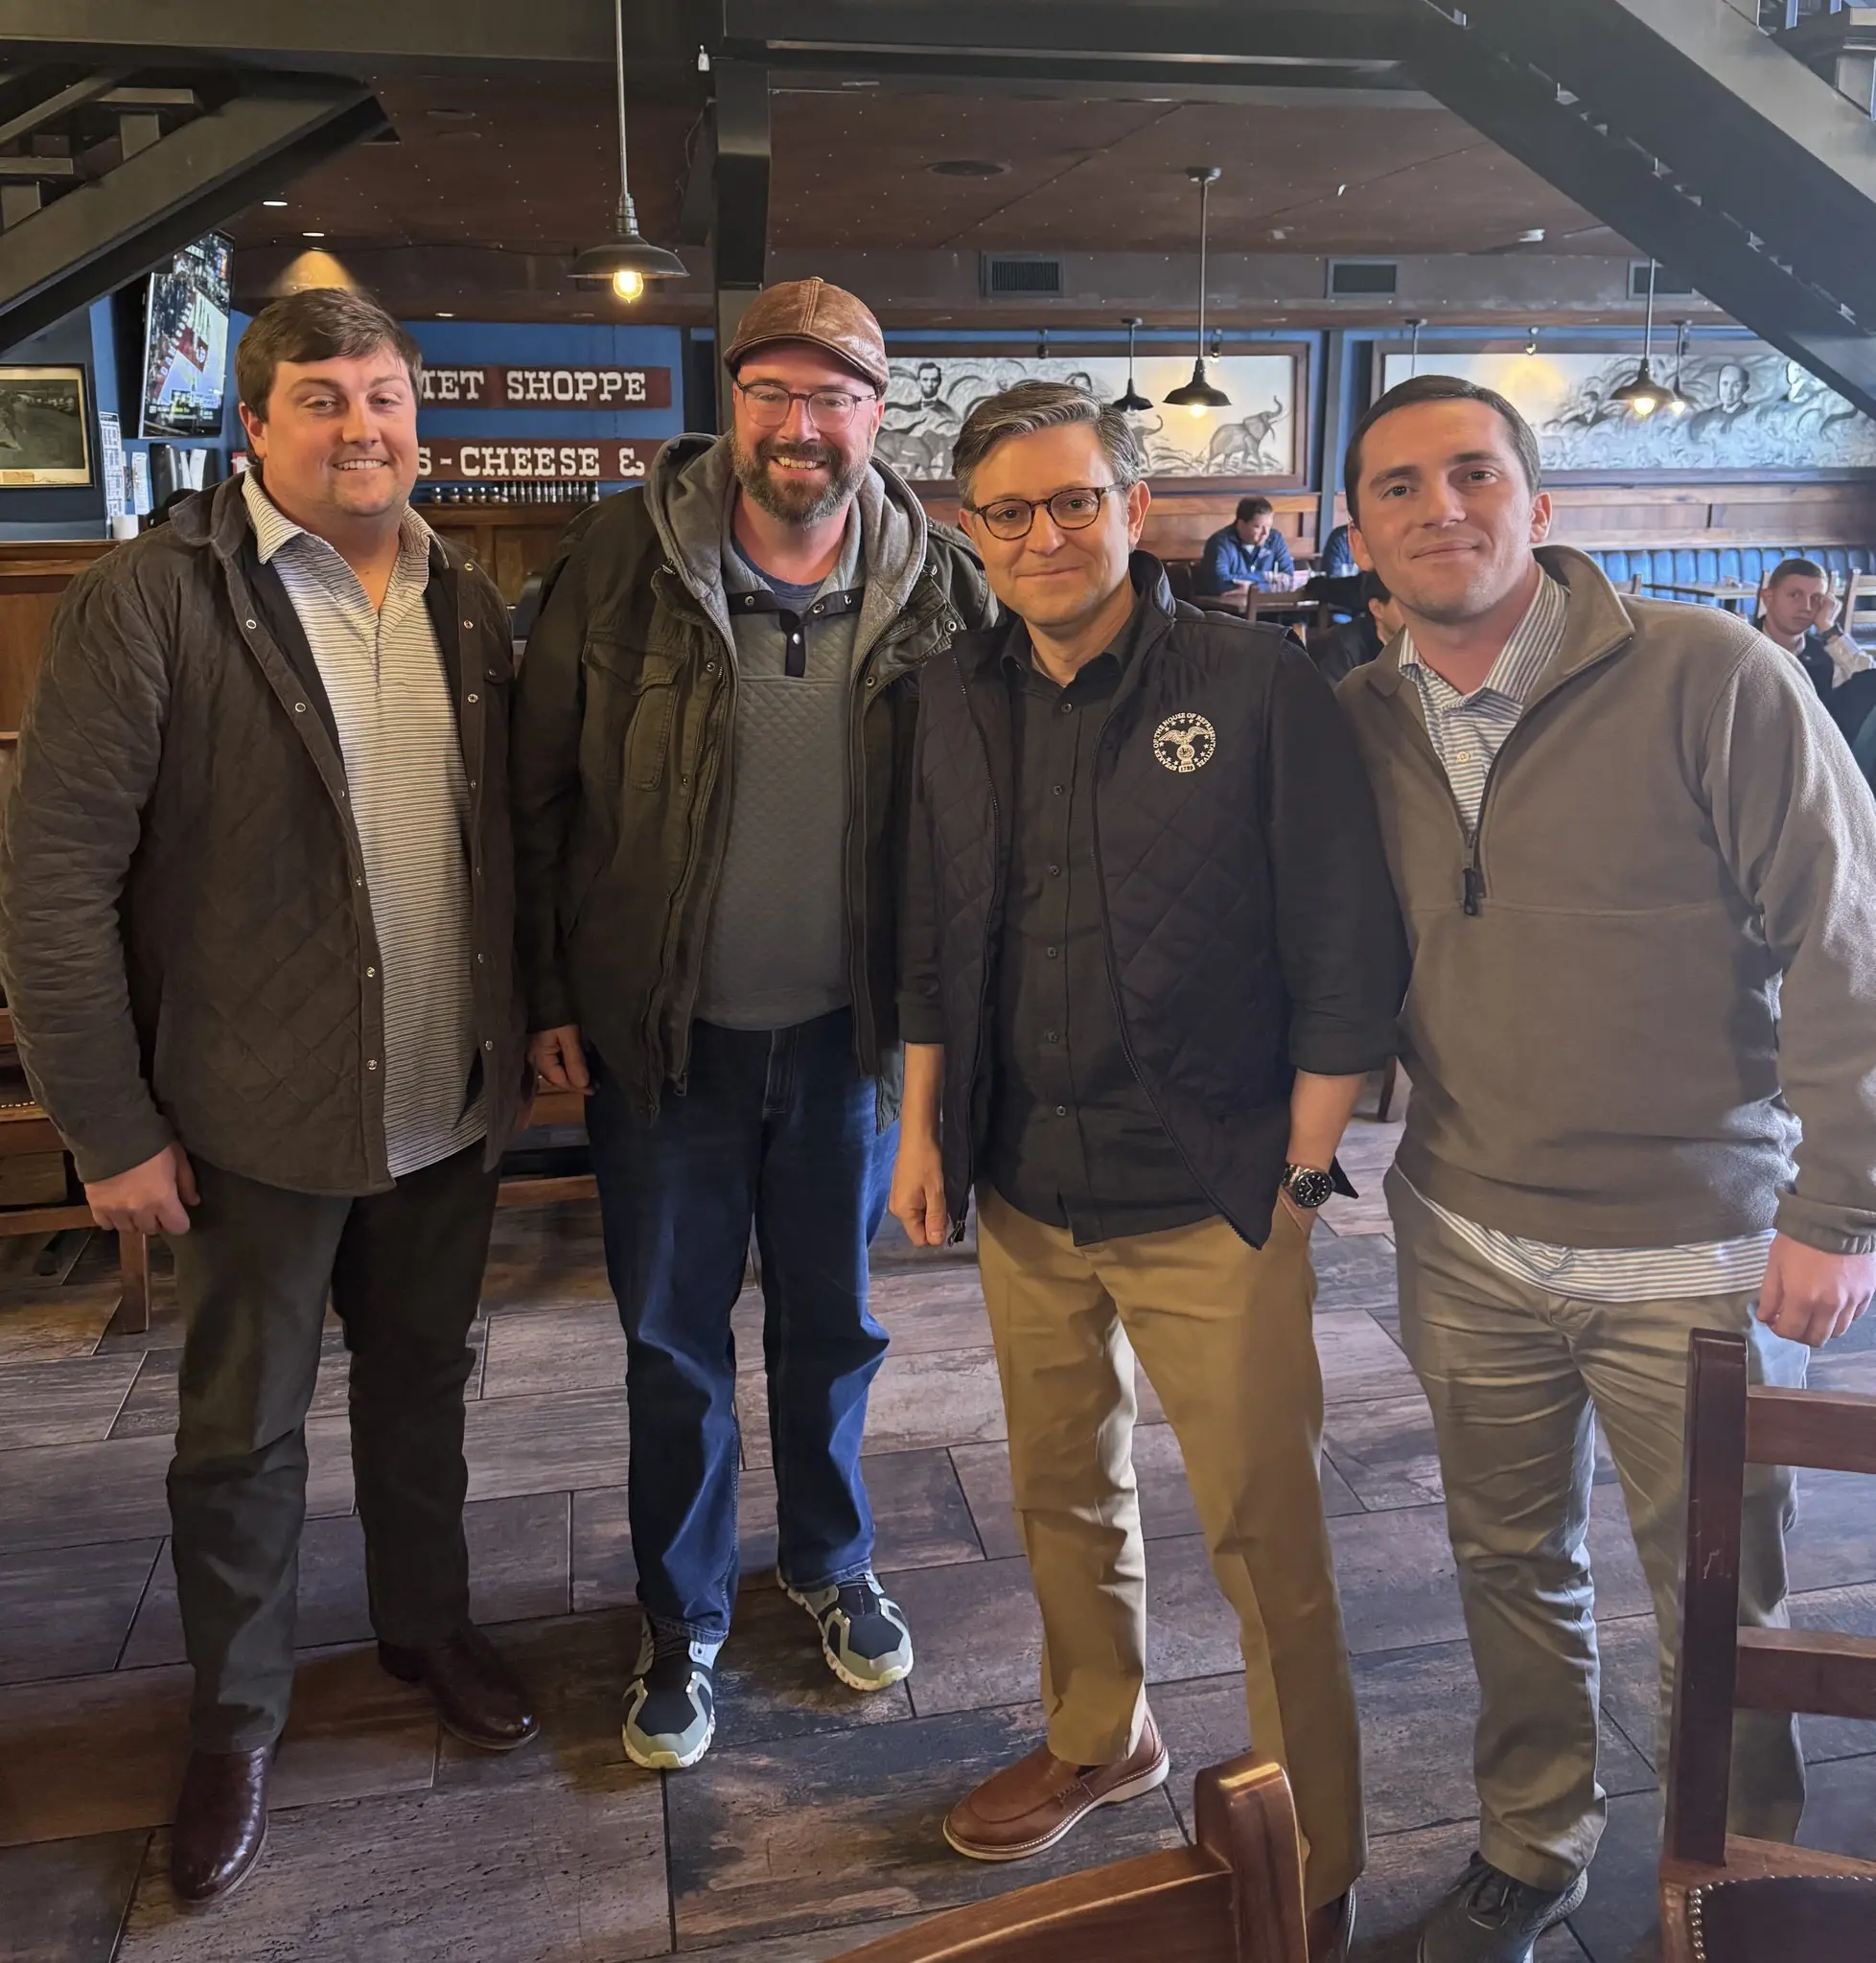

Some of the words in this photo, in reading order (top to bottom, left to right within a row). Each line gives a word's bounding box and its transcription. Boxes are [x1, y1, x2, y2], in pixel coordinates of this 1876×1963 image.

[506, 370, 646, 402] SHOPPE
[618, 447, 645, 476] &
[1162, 712, 1186, 727] HOUSE
[1153, 725, 1165, 738] THE
[1154, 749, 1177, 771] SPEAKER
